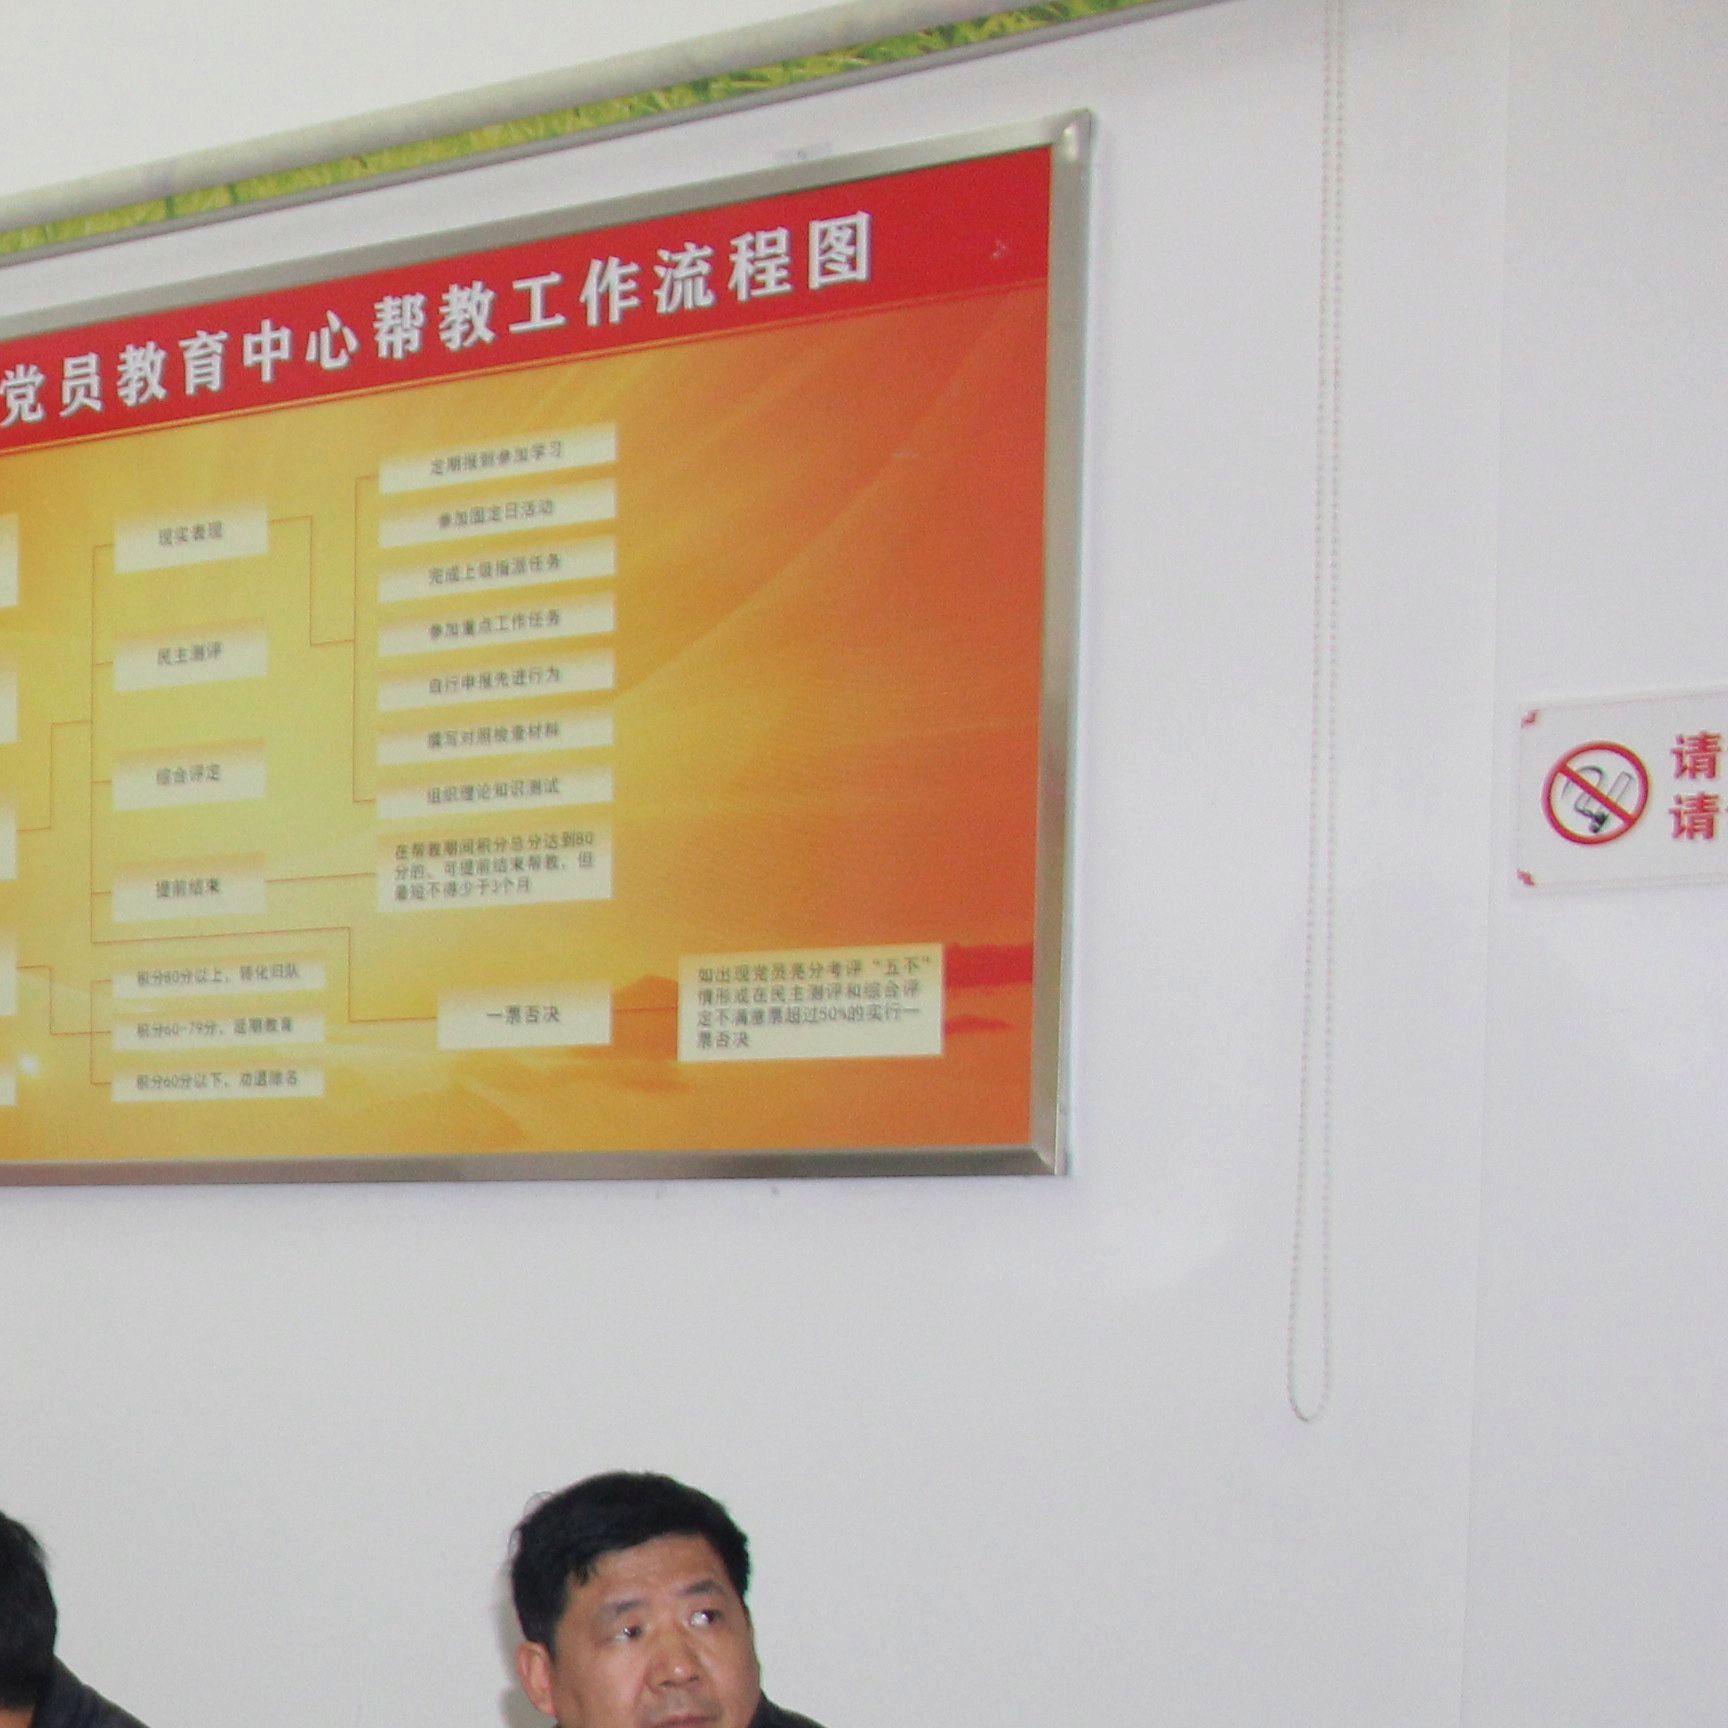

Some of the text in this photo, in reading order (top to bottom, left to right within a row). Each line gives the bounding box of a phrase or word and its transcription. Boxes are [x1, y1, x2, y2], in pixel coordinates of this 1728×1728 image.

[430, 440, 562, 476] 定期报到参加学习
[438, 498, 554, 530] 参加固定日活动
[158, 520, 222, 546] 现实表现
[428, 553, 560, 585] 完成上级指派任务
[429, 609, 560, 641] 参加重点工作任务
[157, 641, 221, 666] 民主测评
[429, 665, 560, 694] 自行申报先进行为
[156, 763, 220, 786] 综合评定
[427, 778, 559, 804] 组织理论知识测试
[156, 877, 220, 899] 提前结束
[486, 1005, 560, 1025] 一票否决
[698, 1031, 749, 1048] 票否决
